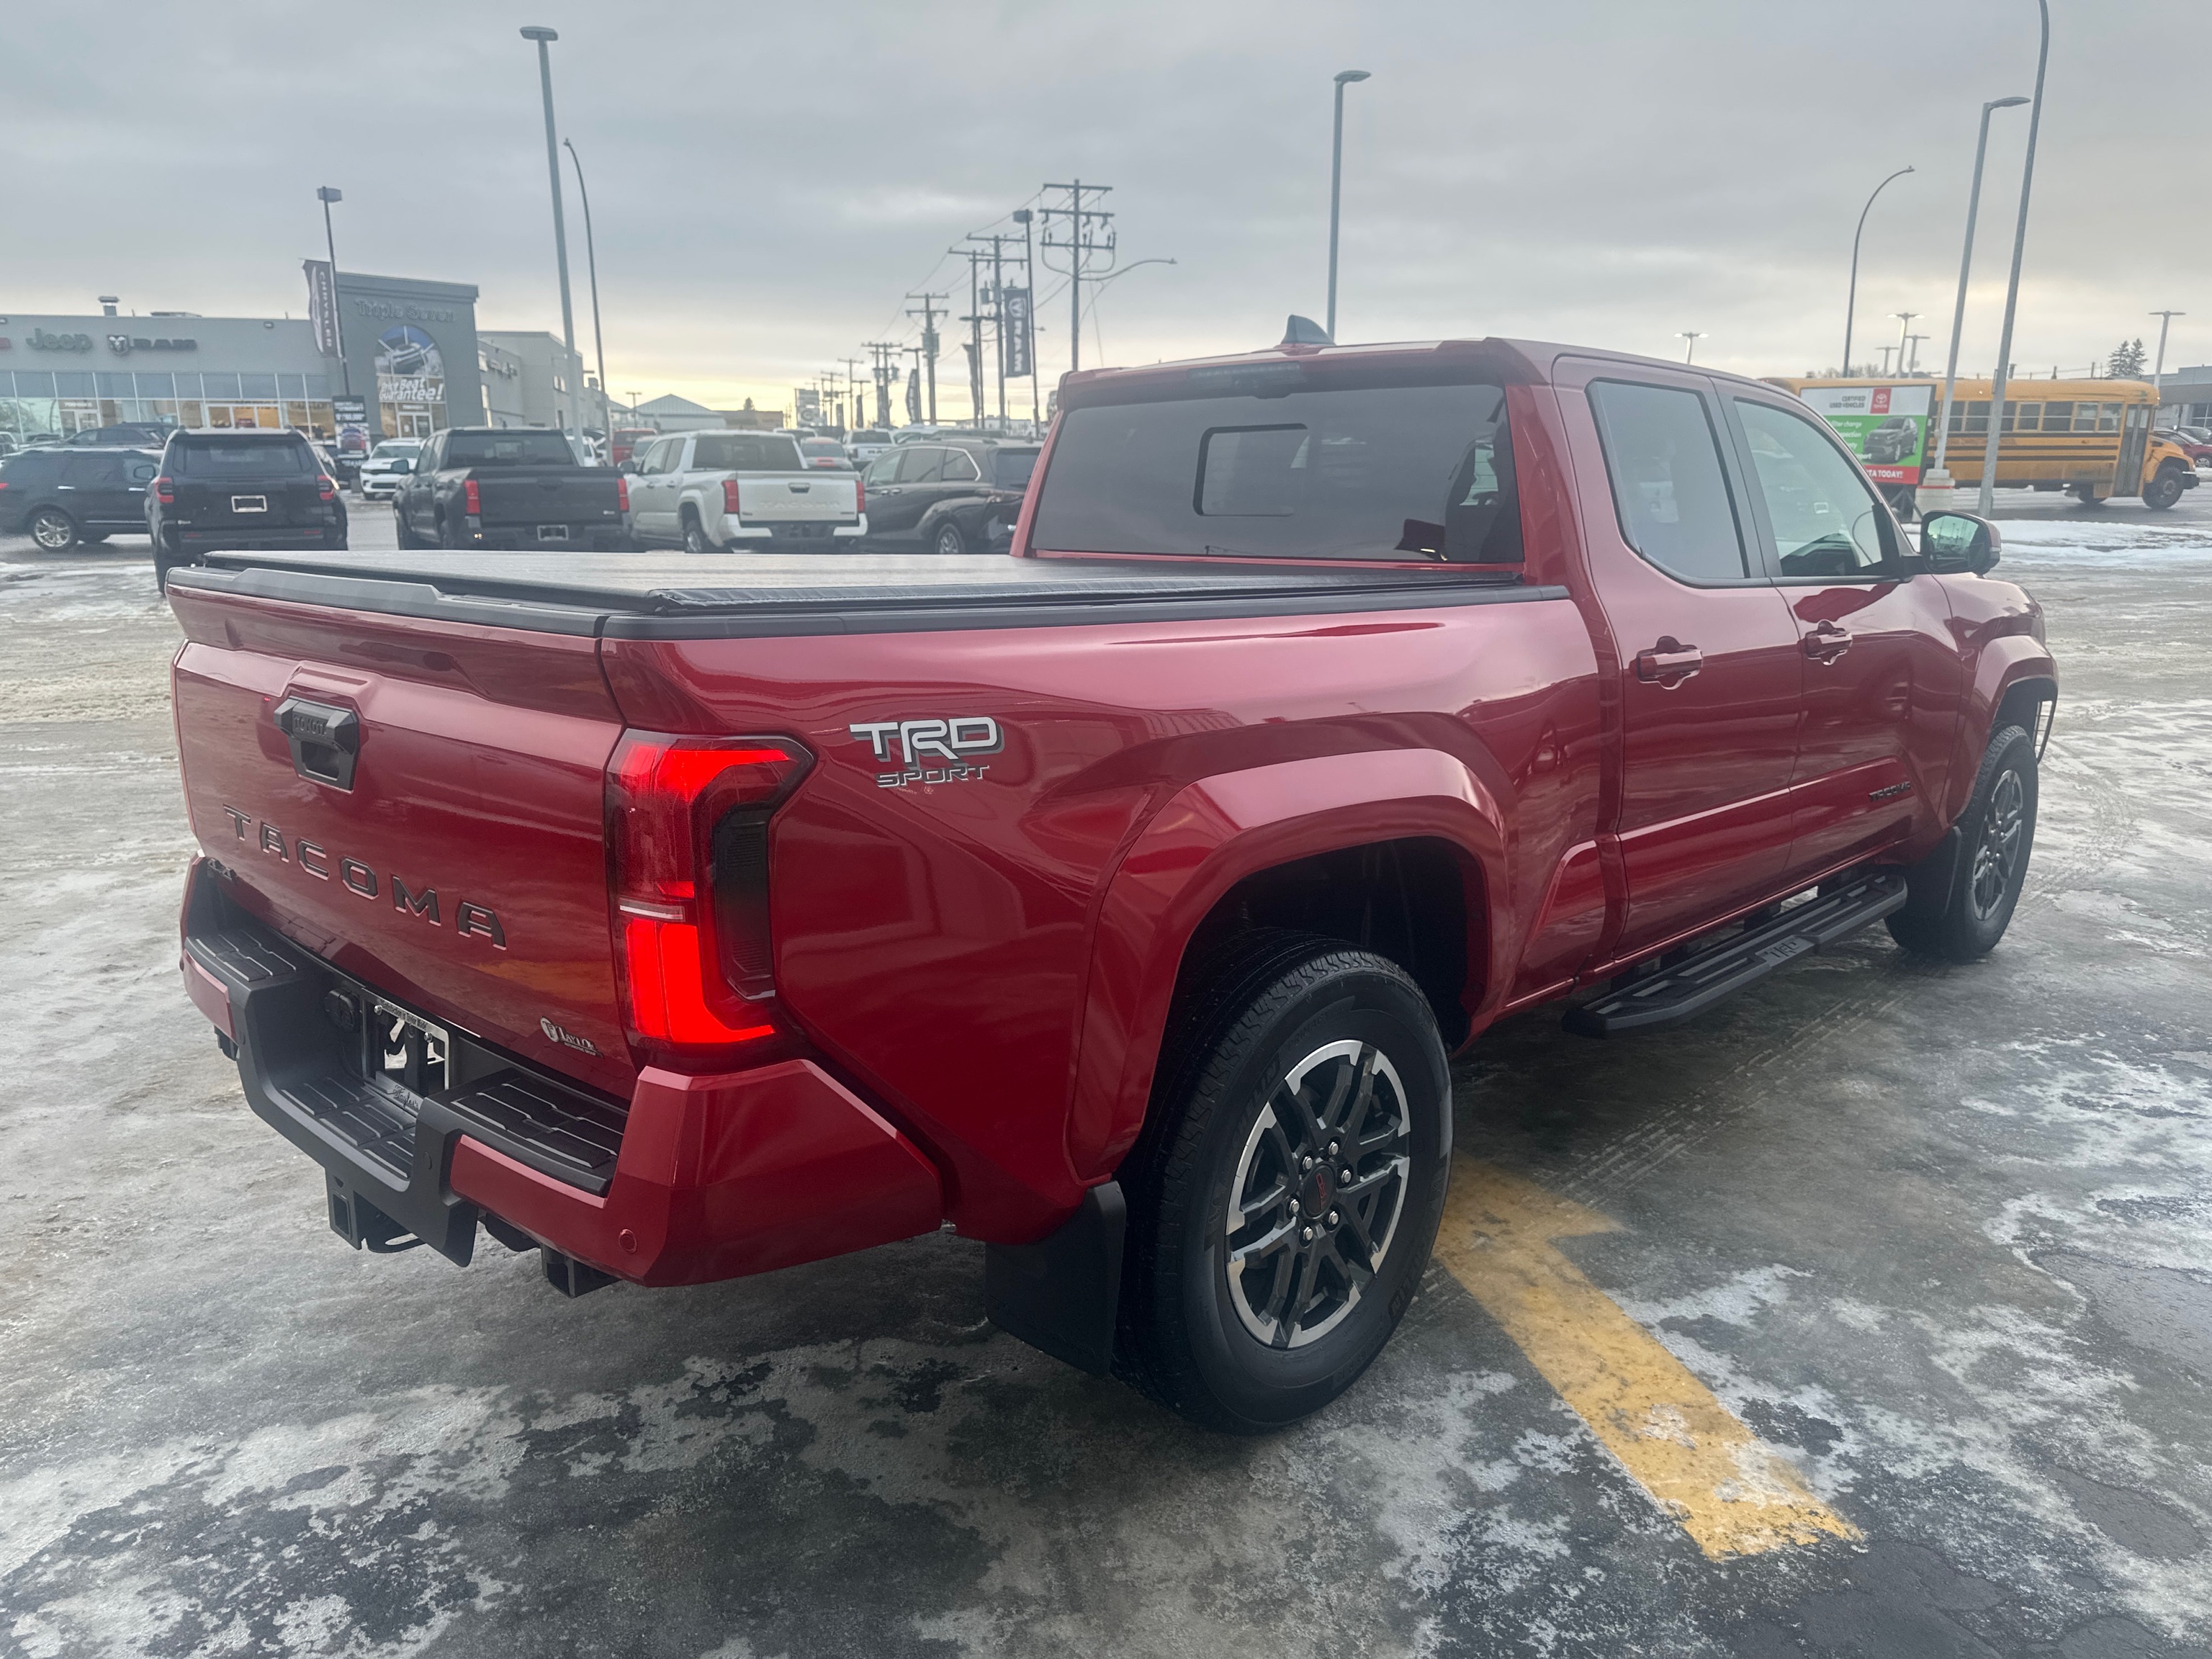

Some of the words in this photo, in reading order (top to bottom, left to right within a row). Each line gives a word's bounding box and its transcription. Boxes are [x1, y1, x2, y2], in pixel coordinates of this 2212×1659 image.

[356, 298, 403, 321] Triple
[406, 303, 456, 323] Seven
[26, 328, 94, 353] Jeep
[132, 338, 197, 350] RAM
[1014, 320, 1022, 372] RAM
[379, 383, 444, 401] Guarantee!
[400, 376, 426, 391] Beat
[1878, 469, 1903, 478] TODAY!
[294, 714, 327, 736] TOYOTA
[848, 716, 1004, 769] TRD
[874, 765, 990, 788] SPORT
[223, 802, 507, 951] TACOMA
[554, 1024, 598, 1051] TAYLOR
